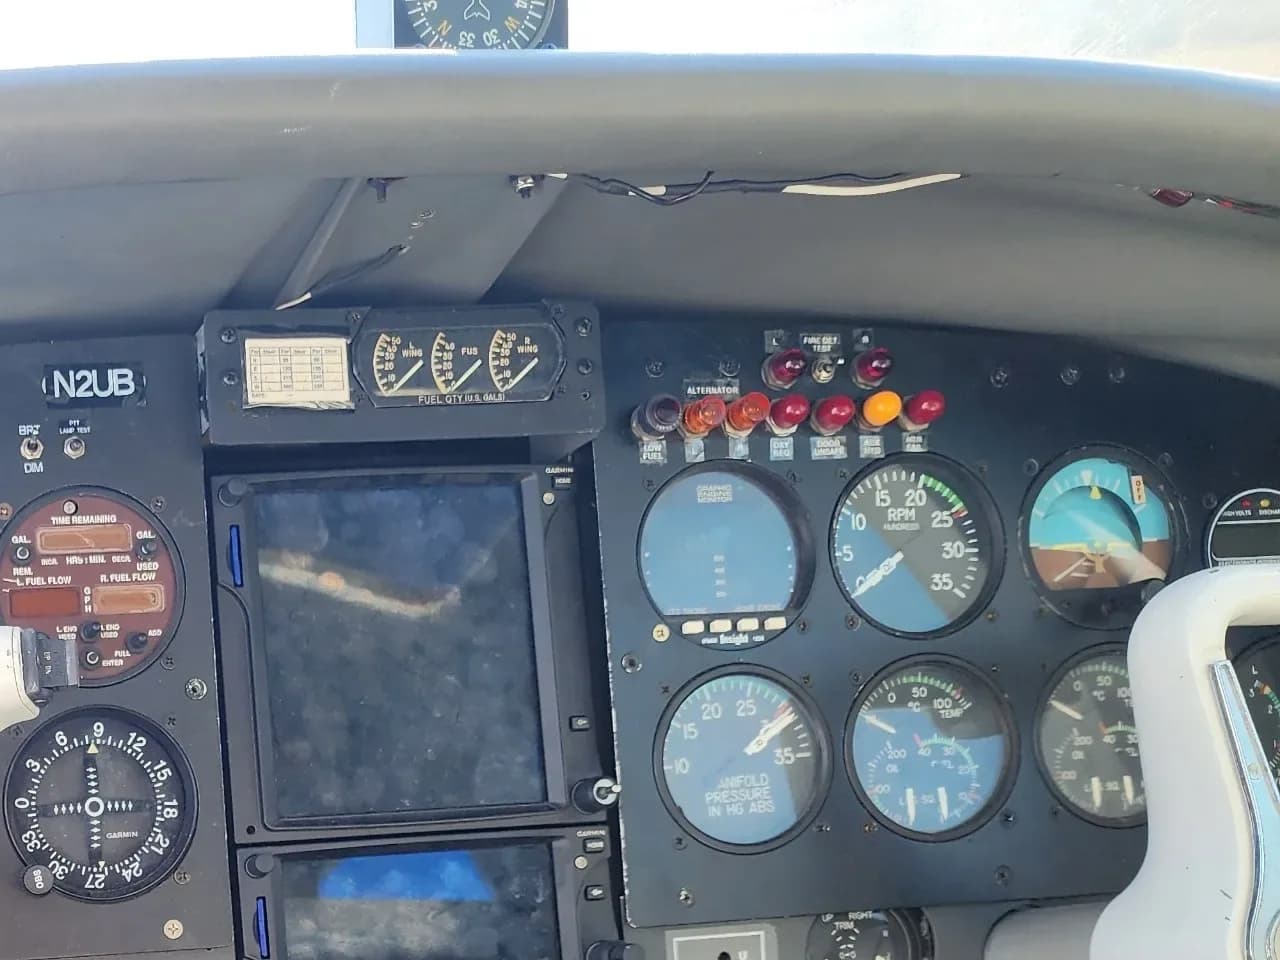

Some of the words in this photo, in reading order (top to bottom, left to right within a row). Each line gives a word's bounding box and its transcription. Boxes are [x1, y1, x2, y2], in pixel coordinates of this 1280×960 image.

[54, 368, 135, 398] N2UB
[687, 386, 738, 395] ALTERNATOR
[419, 395, 442, 404] FUEL
[445, 395, 464, 405] QTY
[24, 462, 43, 473] DIM
[875, 490, 891, 507] 15
[905, 489, 927, 506] 20
[51, 517, 70, 525] TIME
[71, 515, 117, 524] REMAINING
[888, 508, 916, 522] RPM
[931, 511, 953, 528] 25
[941, 541, 965, 559] 30
[136, 563, 159, 571] USED
[47, 576, 71, 585] FLOW
[930, 573, 953, 590] 35
[1097, 676, 1112, 686] 50
[911, 687, 928, 697] 50
[701, 703, 722, 720] 20
[736, 700, 756, 717] 25
[683, 723, 698, 739] 15
[127, 732, 147, 752] 12
[774, 747, 795, 764] 35
[153, 759, 172, 781] 15
[674, 758, 689, 774] 10
[705, 789, 770, 804] PRESSURE
[21, 830, 41, 852] 33
[106, 831, 138, 840] GARMIN
[150, 833, 170, 855] 21
[122, 862, 143, 883] 24
